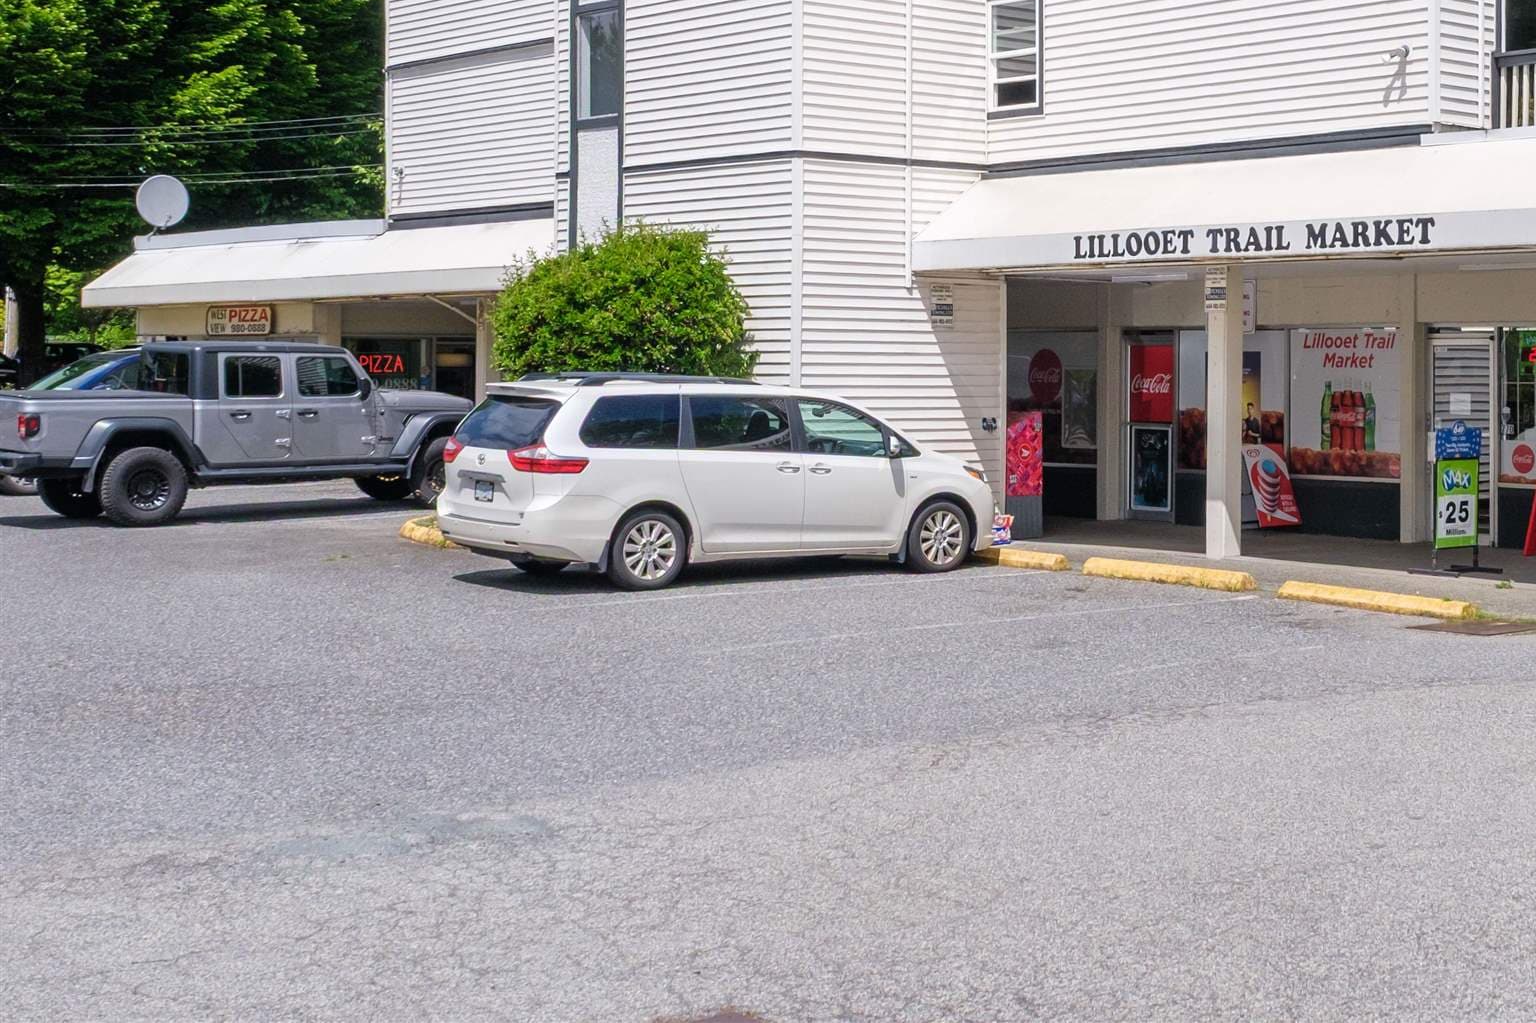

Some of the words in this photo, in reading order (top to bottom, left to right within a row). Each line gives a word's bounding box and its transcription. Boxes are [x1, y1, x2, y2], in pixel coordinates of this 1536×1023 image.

[1073, 229, 1194, 259] LILLOOET
[1206, 225, 1291, 254] TRAIL
[1305, 217, 1435, 249] MARKET
[228, 308, 269, 323] PIZZA
[1303, 333, 1359, 349] Lillooet
[1364, 333, 1396, 349] Trail
[359, 354, 405, 373] PIZZA
[1323, 352, 1374, 369] Market
[1443, 470, 1471, 491] MAX
